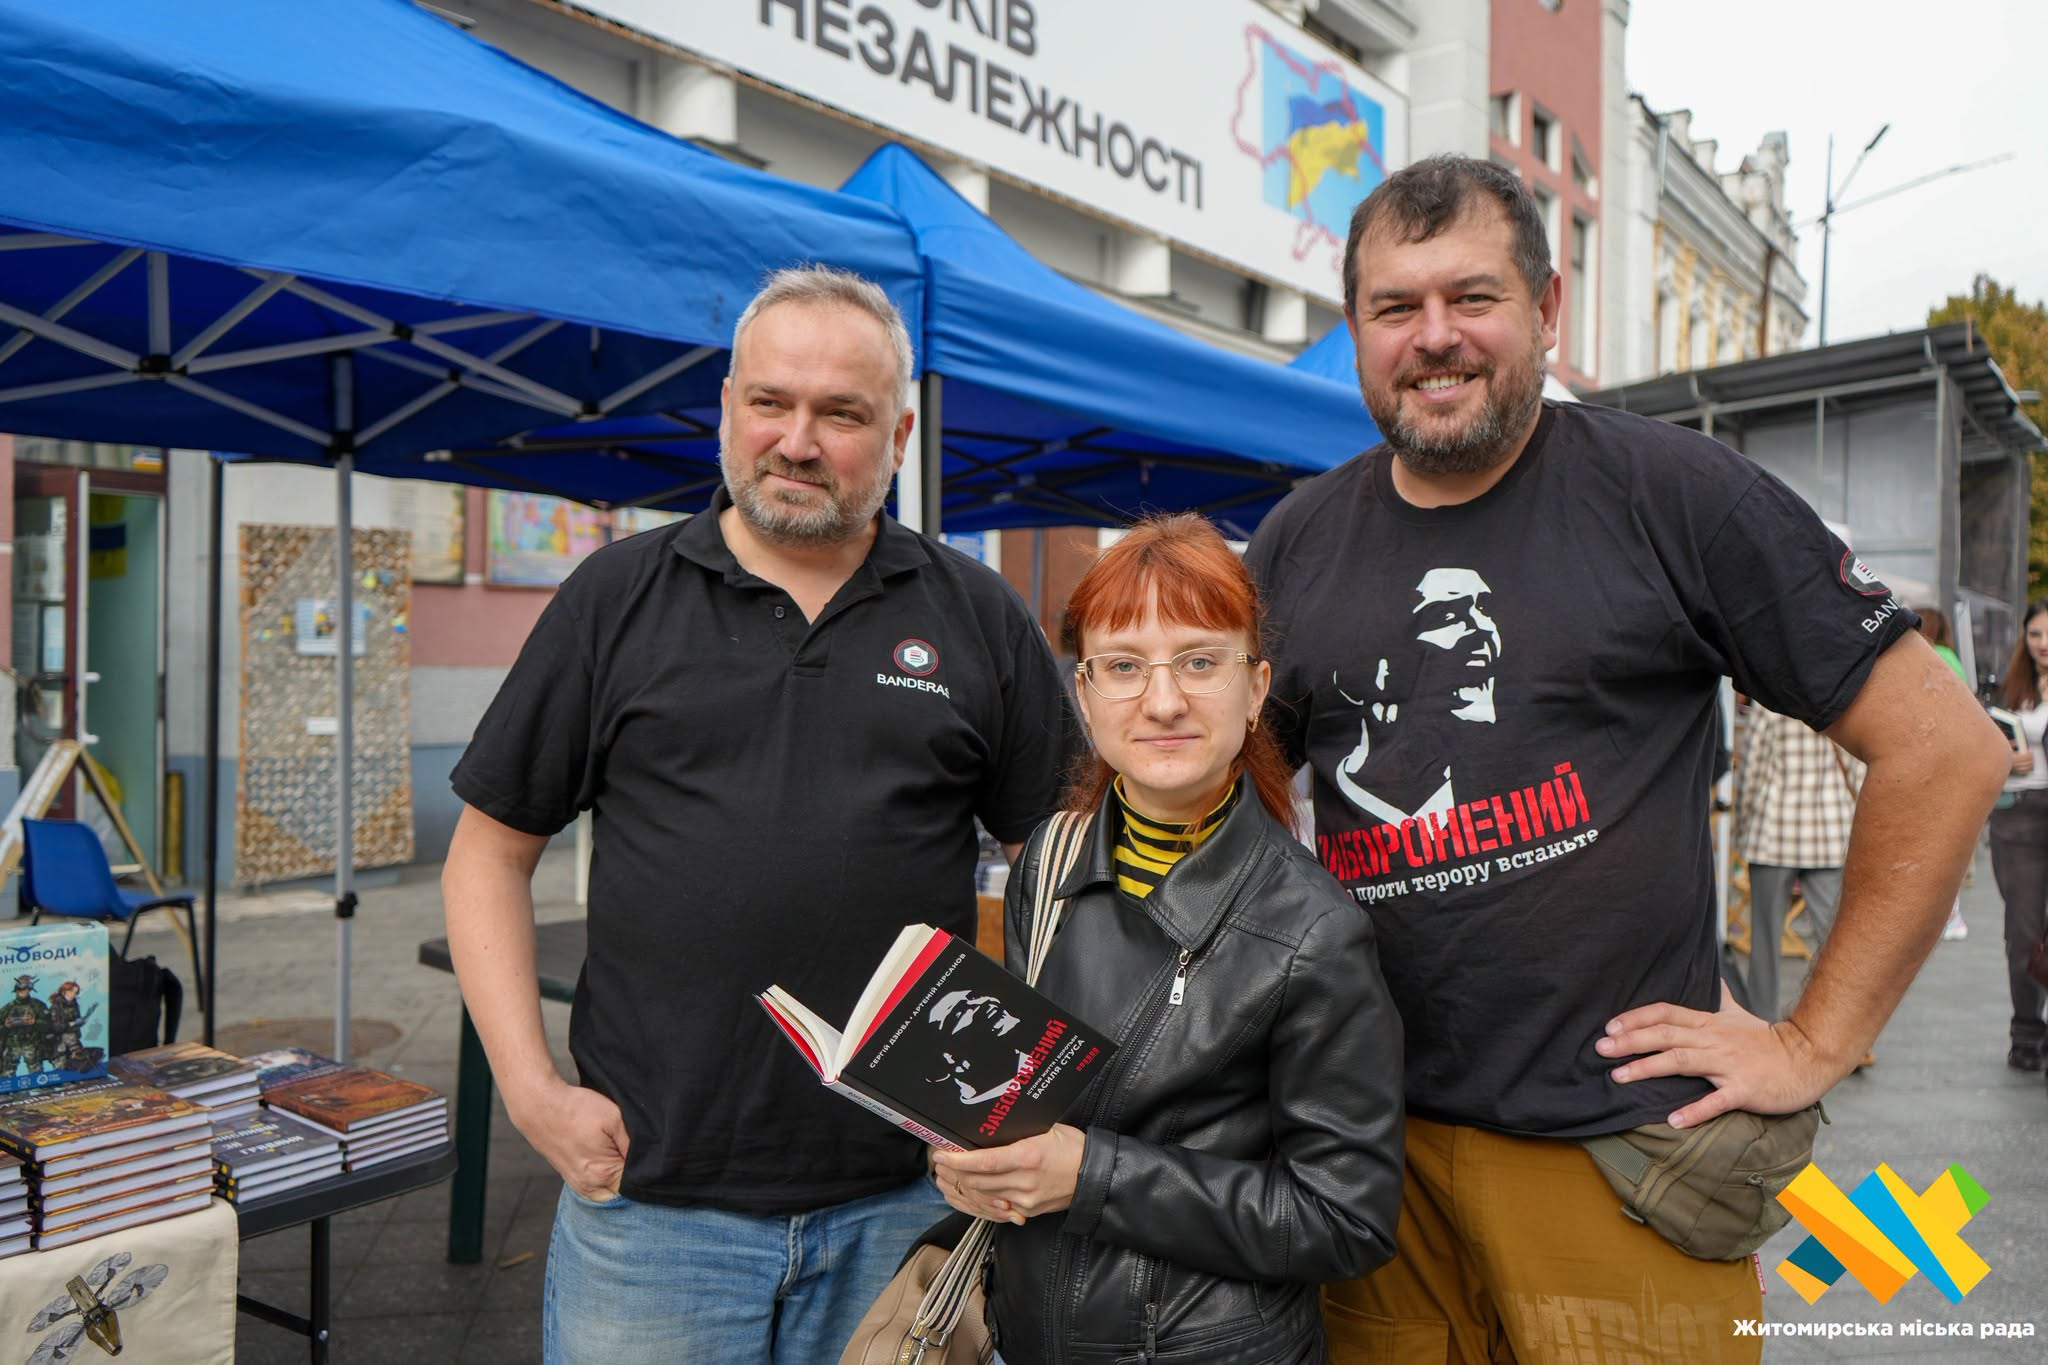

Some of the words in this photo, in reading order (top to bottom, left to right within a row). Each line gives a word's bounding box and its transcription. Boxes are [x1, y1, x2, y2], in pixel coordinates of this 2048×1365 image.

[759, 0, 1203, 210] НЕЗАЛЕЖНОСТІ
[1356, 880, 1409, 905] проти
[1411, 860, 1490, 892] терору
[1496, 828, 1599, 872] встаньте
[869, 1044, 891, 1069] СЕРГІЙ
[889, 1020, 911, 1046] ДЗЮБА
[912, 986, 938, 1017] АРТЕМІЙ
[936, 953, 966, 987] КІРСАНОВ
[979, 1018, 1068, 1136] ЗАБОРОНЕНИЙ
[1026, 1077, 1043, 1096] ІСТОРІЯ
[1041, 1061, 1057, 1078] ЖИТТЯ
[1032, 1066, 1062, 1100] ВАСИЛЯ
[1060, 1039, 1086, 1065] СТУСА
